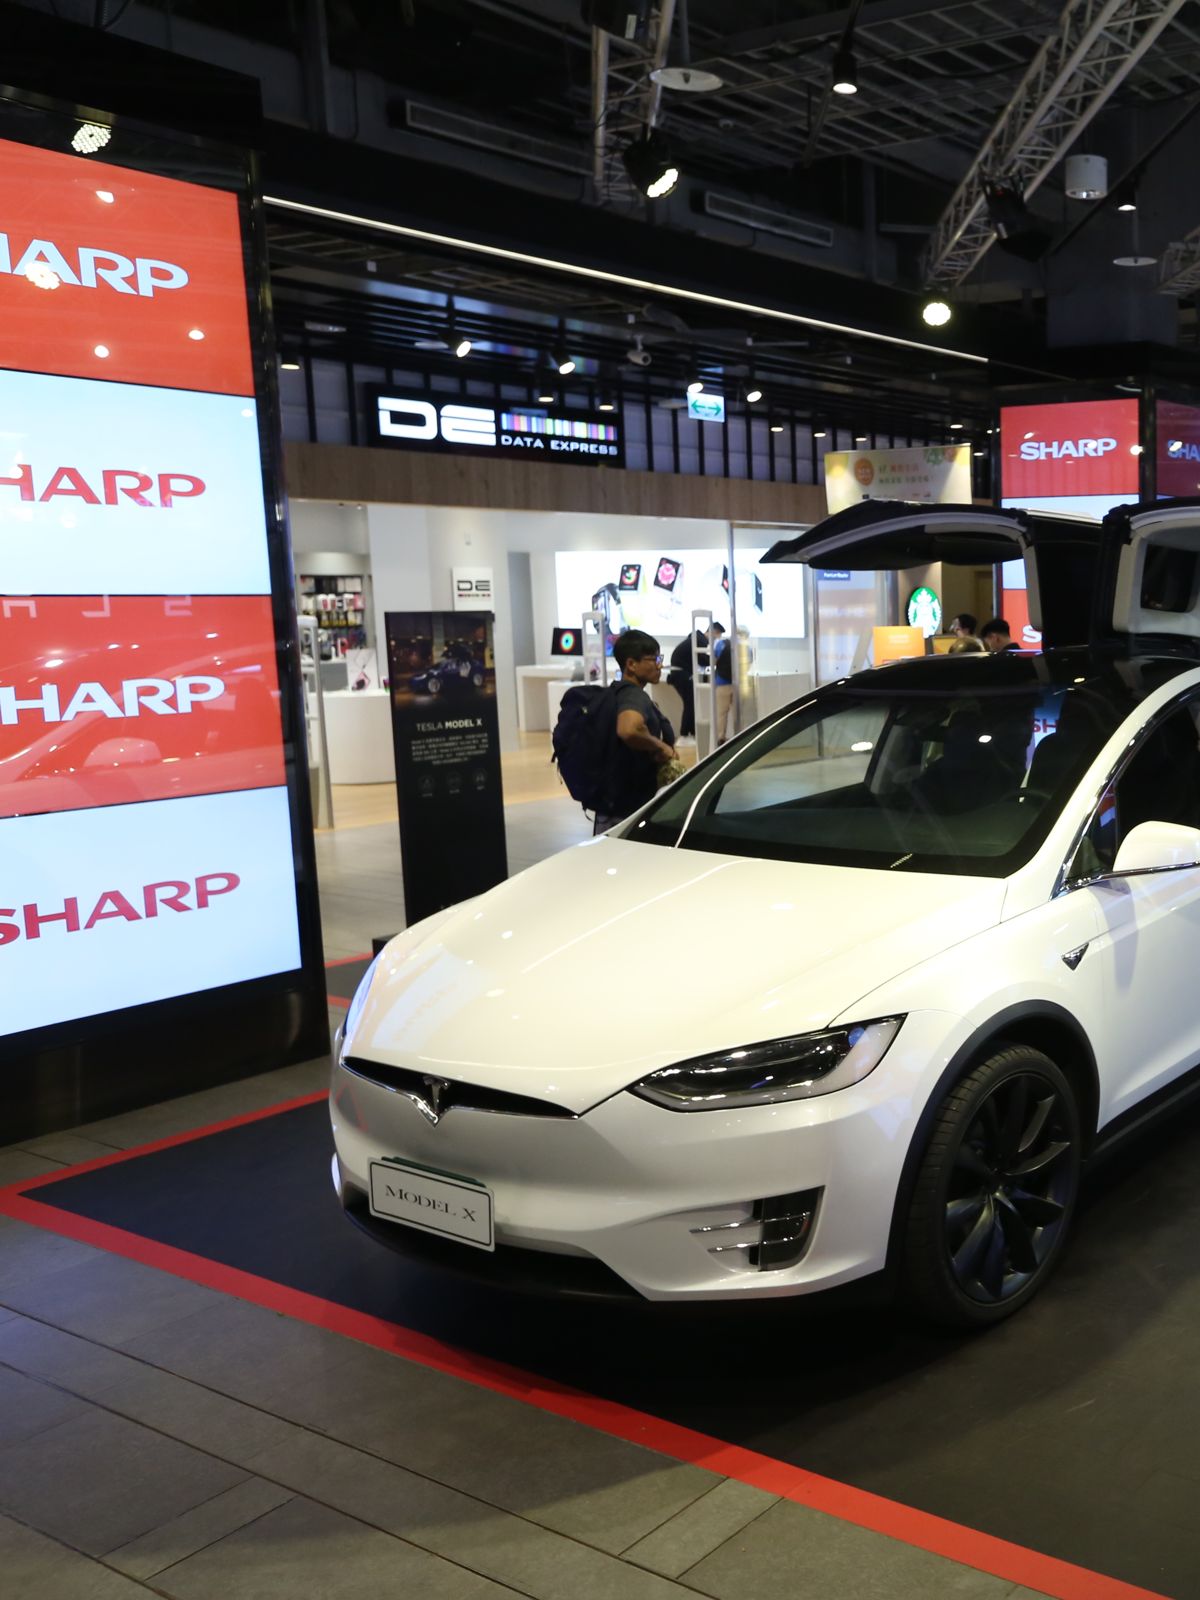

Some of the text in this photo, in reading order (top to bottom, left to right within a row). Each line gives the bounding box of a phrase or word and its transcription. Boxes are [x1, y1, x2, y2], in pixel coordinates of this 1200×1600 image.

[377, 396, 497, 447] DE
[500, 434, 618, 456] DATA EXPRESS
[1020, 437, 1117, 461] SHARP
[416, 718, 483, 732] TESLA MODEL X
[385, 1184, 477, 1223] MODEL X
